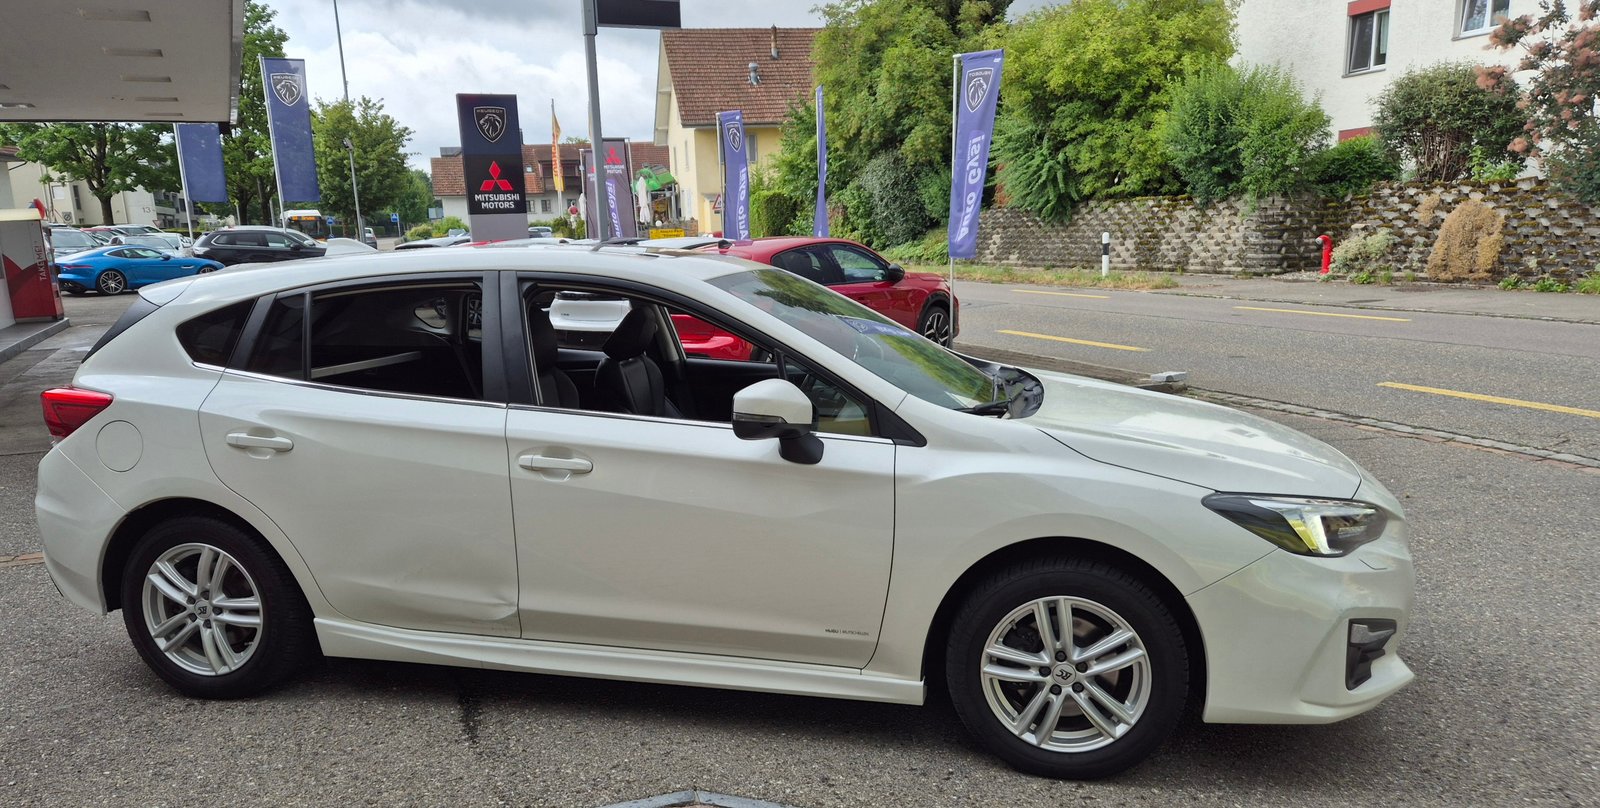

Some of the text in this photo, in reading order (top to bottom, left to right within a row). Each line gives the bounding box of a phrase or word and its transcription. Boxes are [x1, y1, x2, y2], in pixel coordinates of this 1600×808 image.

[474, 193, 520, 201] MITSUBISHI
[481, 201, 515, 209] MOTORS
[36, 258, 47, 281] TAKE
